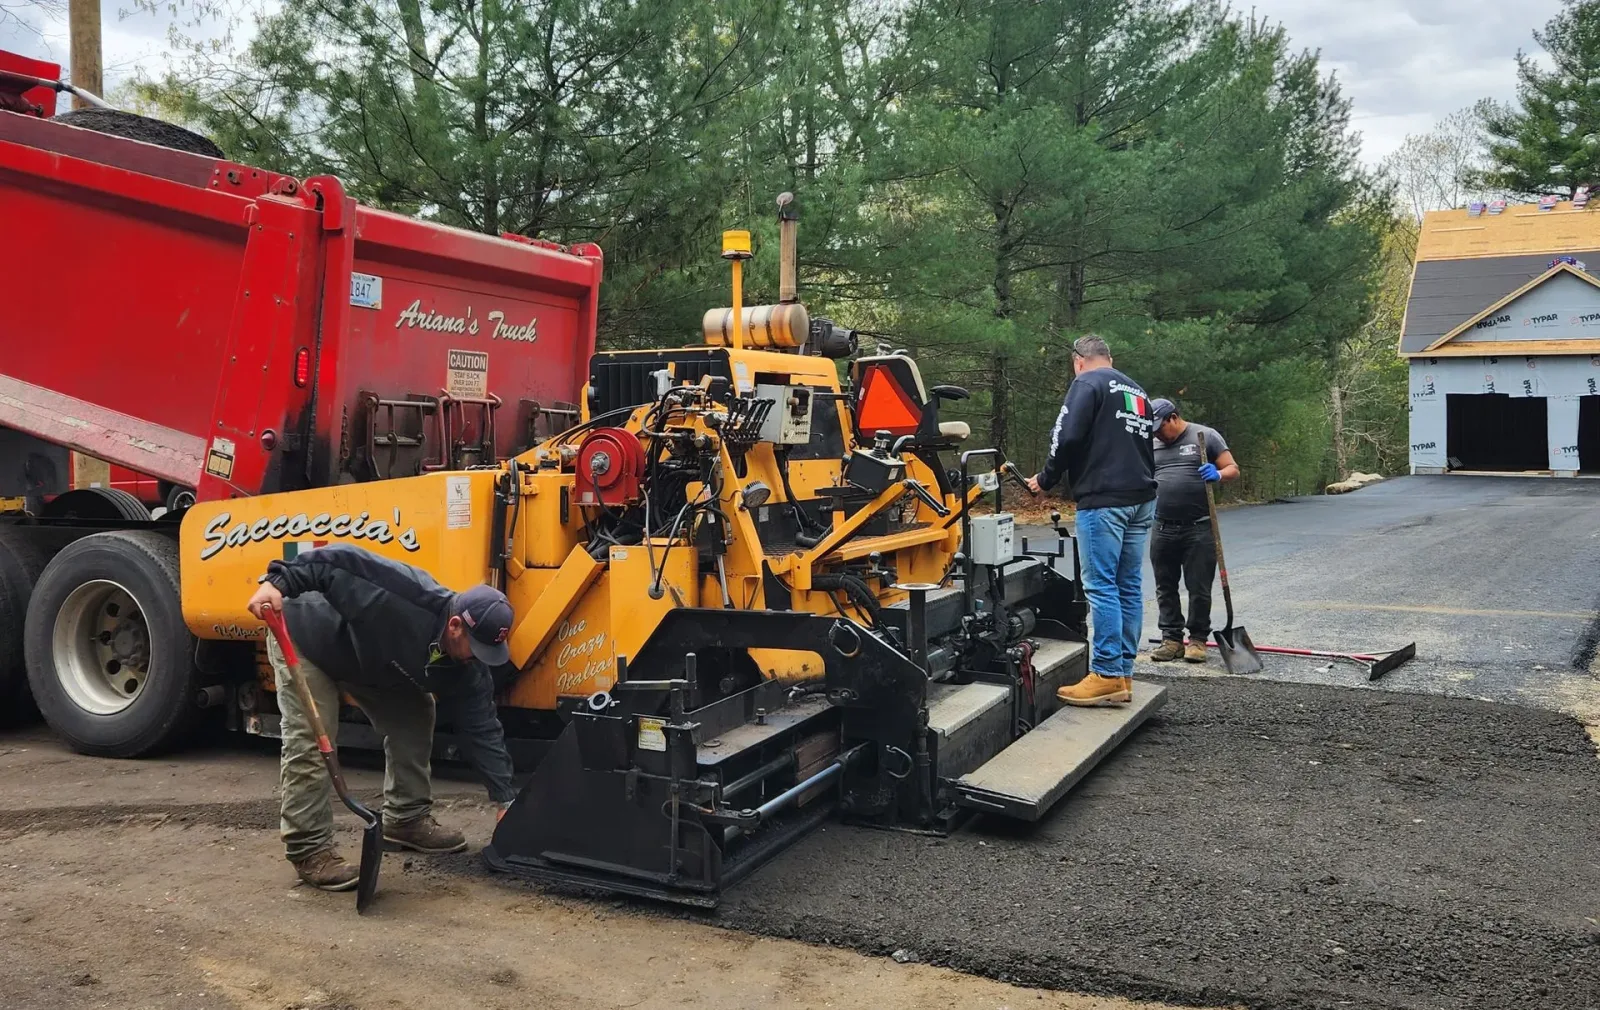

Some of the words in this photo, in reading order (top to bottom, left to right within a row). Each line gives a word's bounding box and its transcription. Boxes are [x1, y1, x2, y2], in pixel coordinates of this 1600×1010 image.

[395, 299, 480, 336] Ariana's
[488, 310, 538, 343] Truck
[1531, 313, 1558, 324] TYPAR
[450, 353, 486, 370] CAUTION
[466, 373, 480, 381] BACK
[1411, 441, 1436, 451] TYPAR
[200, 506, 420, 561] Saccoccia's
[558, 619, 586, 642] One
[556, 632, 607, 669] Crazy
